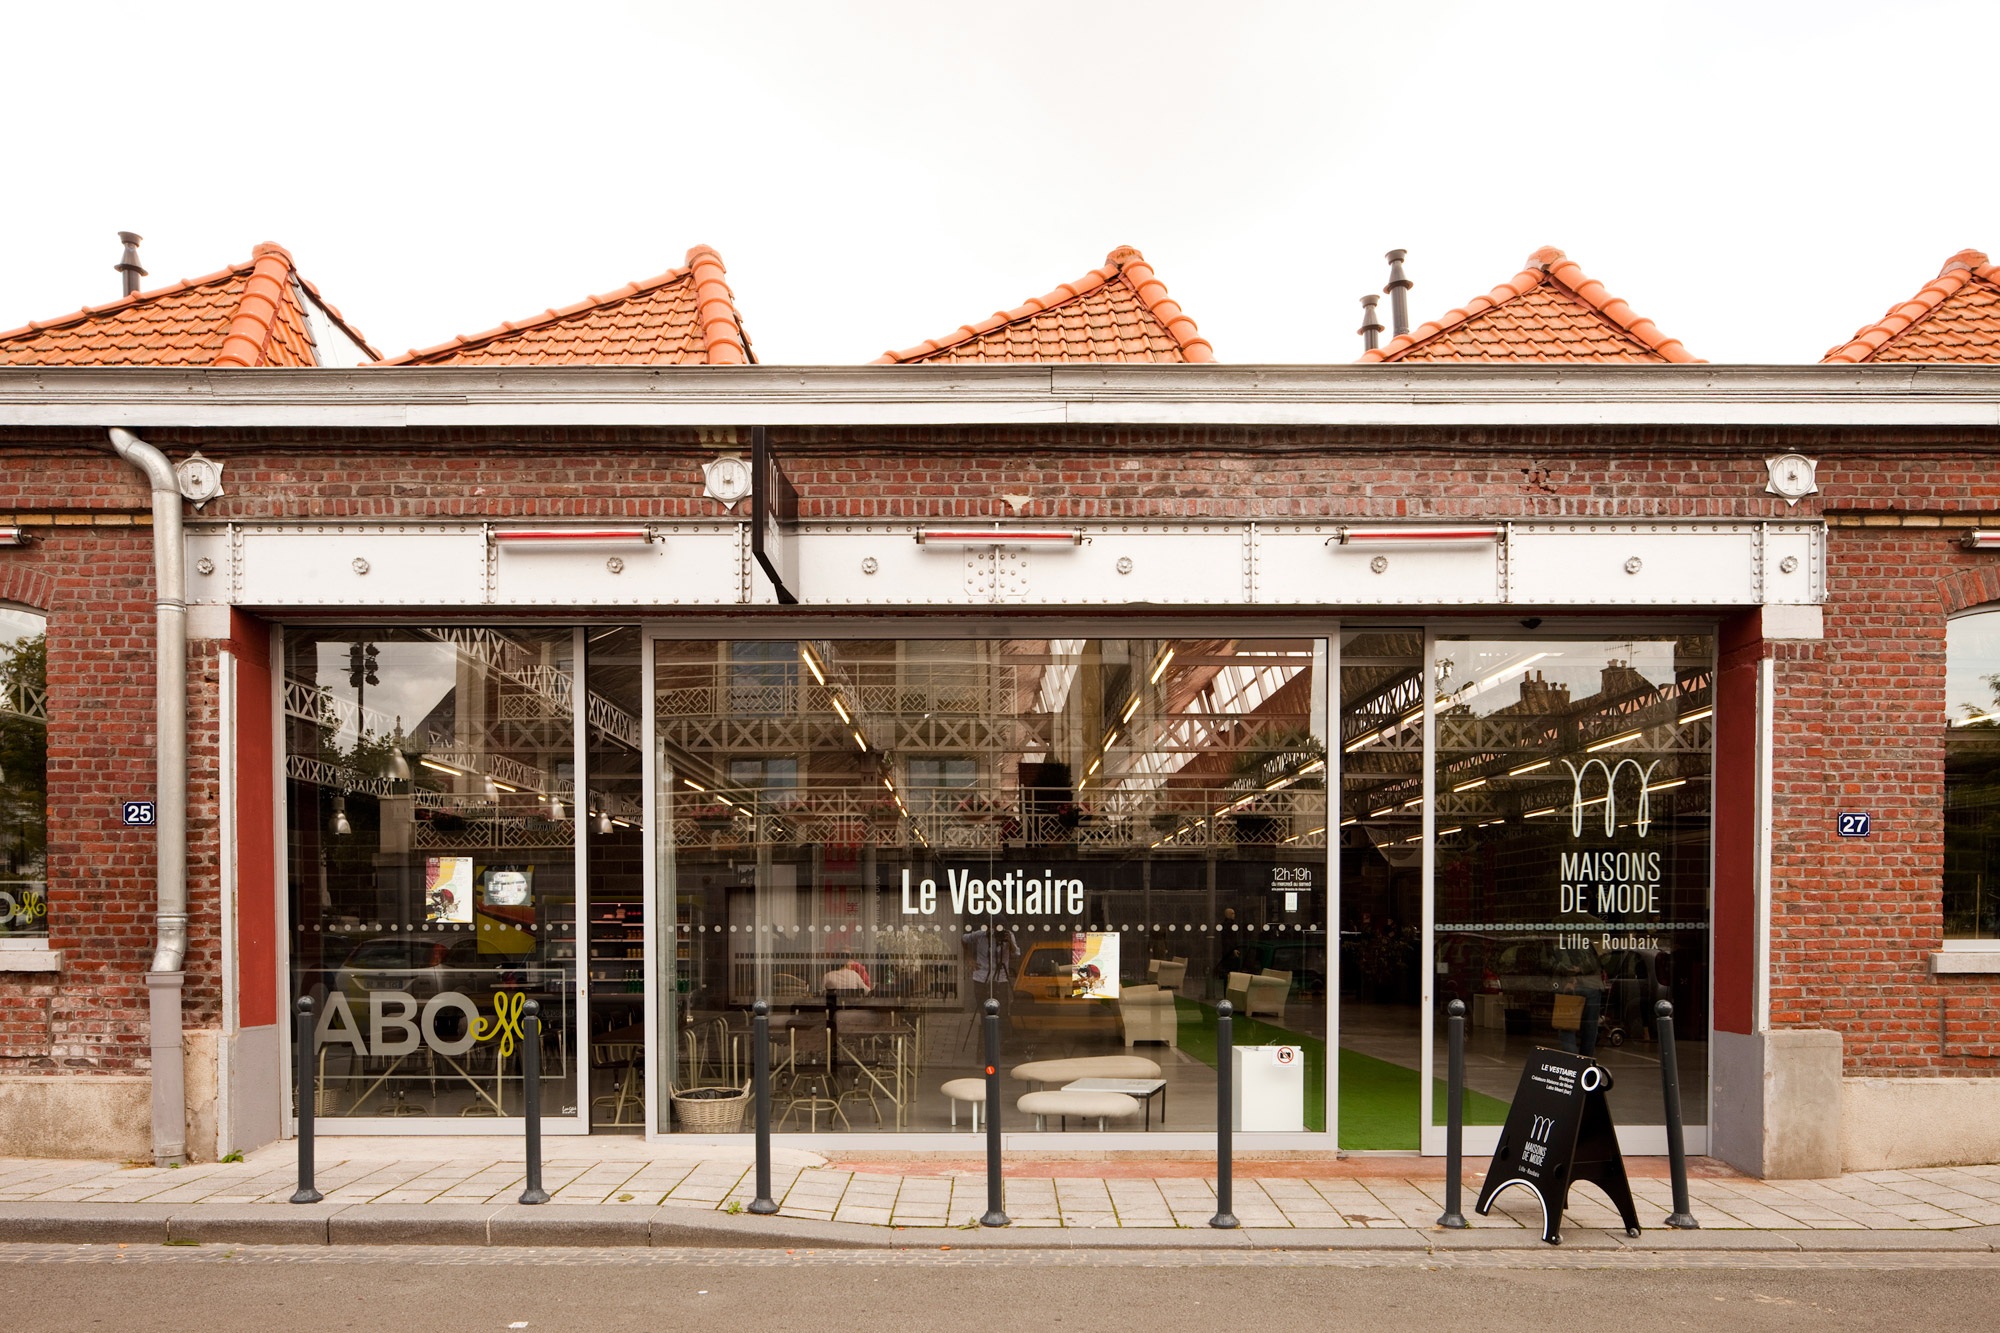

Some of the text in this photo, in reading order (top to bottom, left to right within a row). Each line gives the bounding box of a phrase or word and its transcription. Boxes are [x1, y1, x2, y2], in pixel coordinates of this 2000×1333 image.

[128, 805, 151, 822] 25
[1843, 816, 1867, 833] 27
[1272, 867, 1312, 881] 12h-19h
[1560, 852, 1661, 882] MAISONS
[902, 868, 937, 915] Le
[947, 868, 1084, 915] Vestiaire
[1560, 884, 1588, 913] DE
[1597, 884, 1661, 913] MODE
[1559, 933, 1590, 950] Lille
[1602, 933, 1659, 950] Roubaix
[1541, 1063, 1578, 1078] LE VESTIAIRE
[1524, 1141, 1548, 1157] MAISONS
[1521, 1150, 1545, 1167] DE MODE
